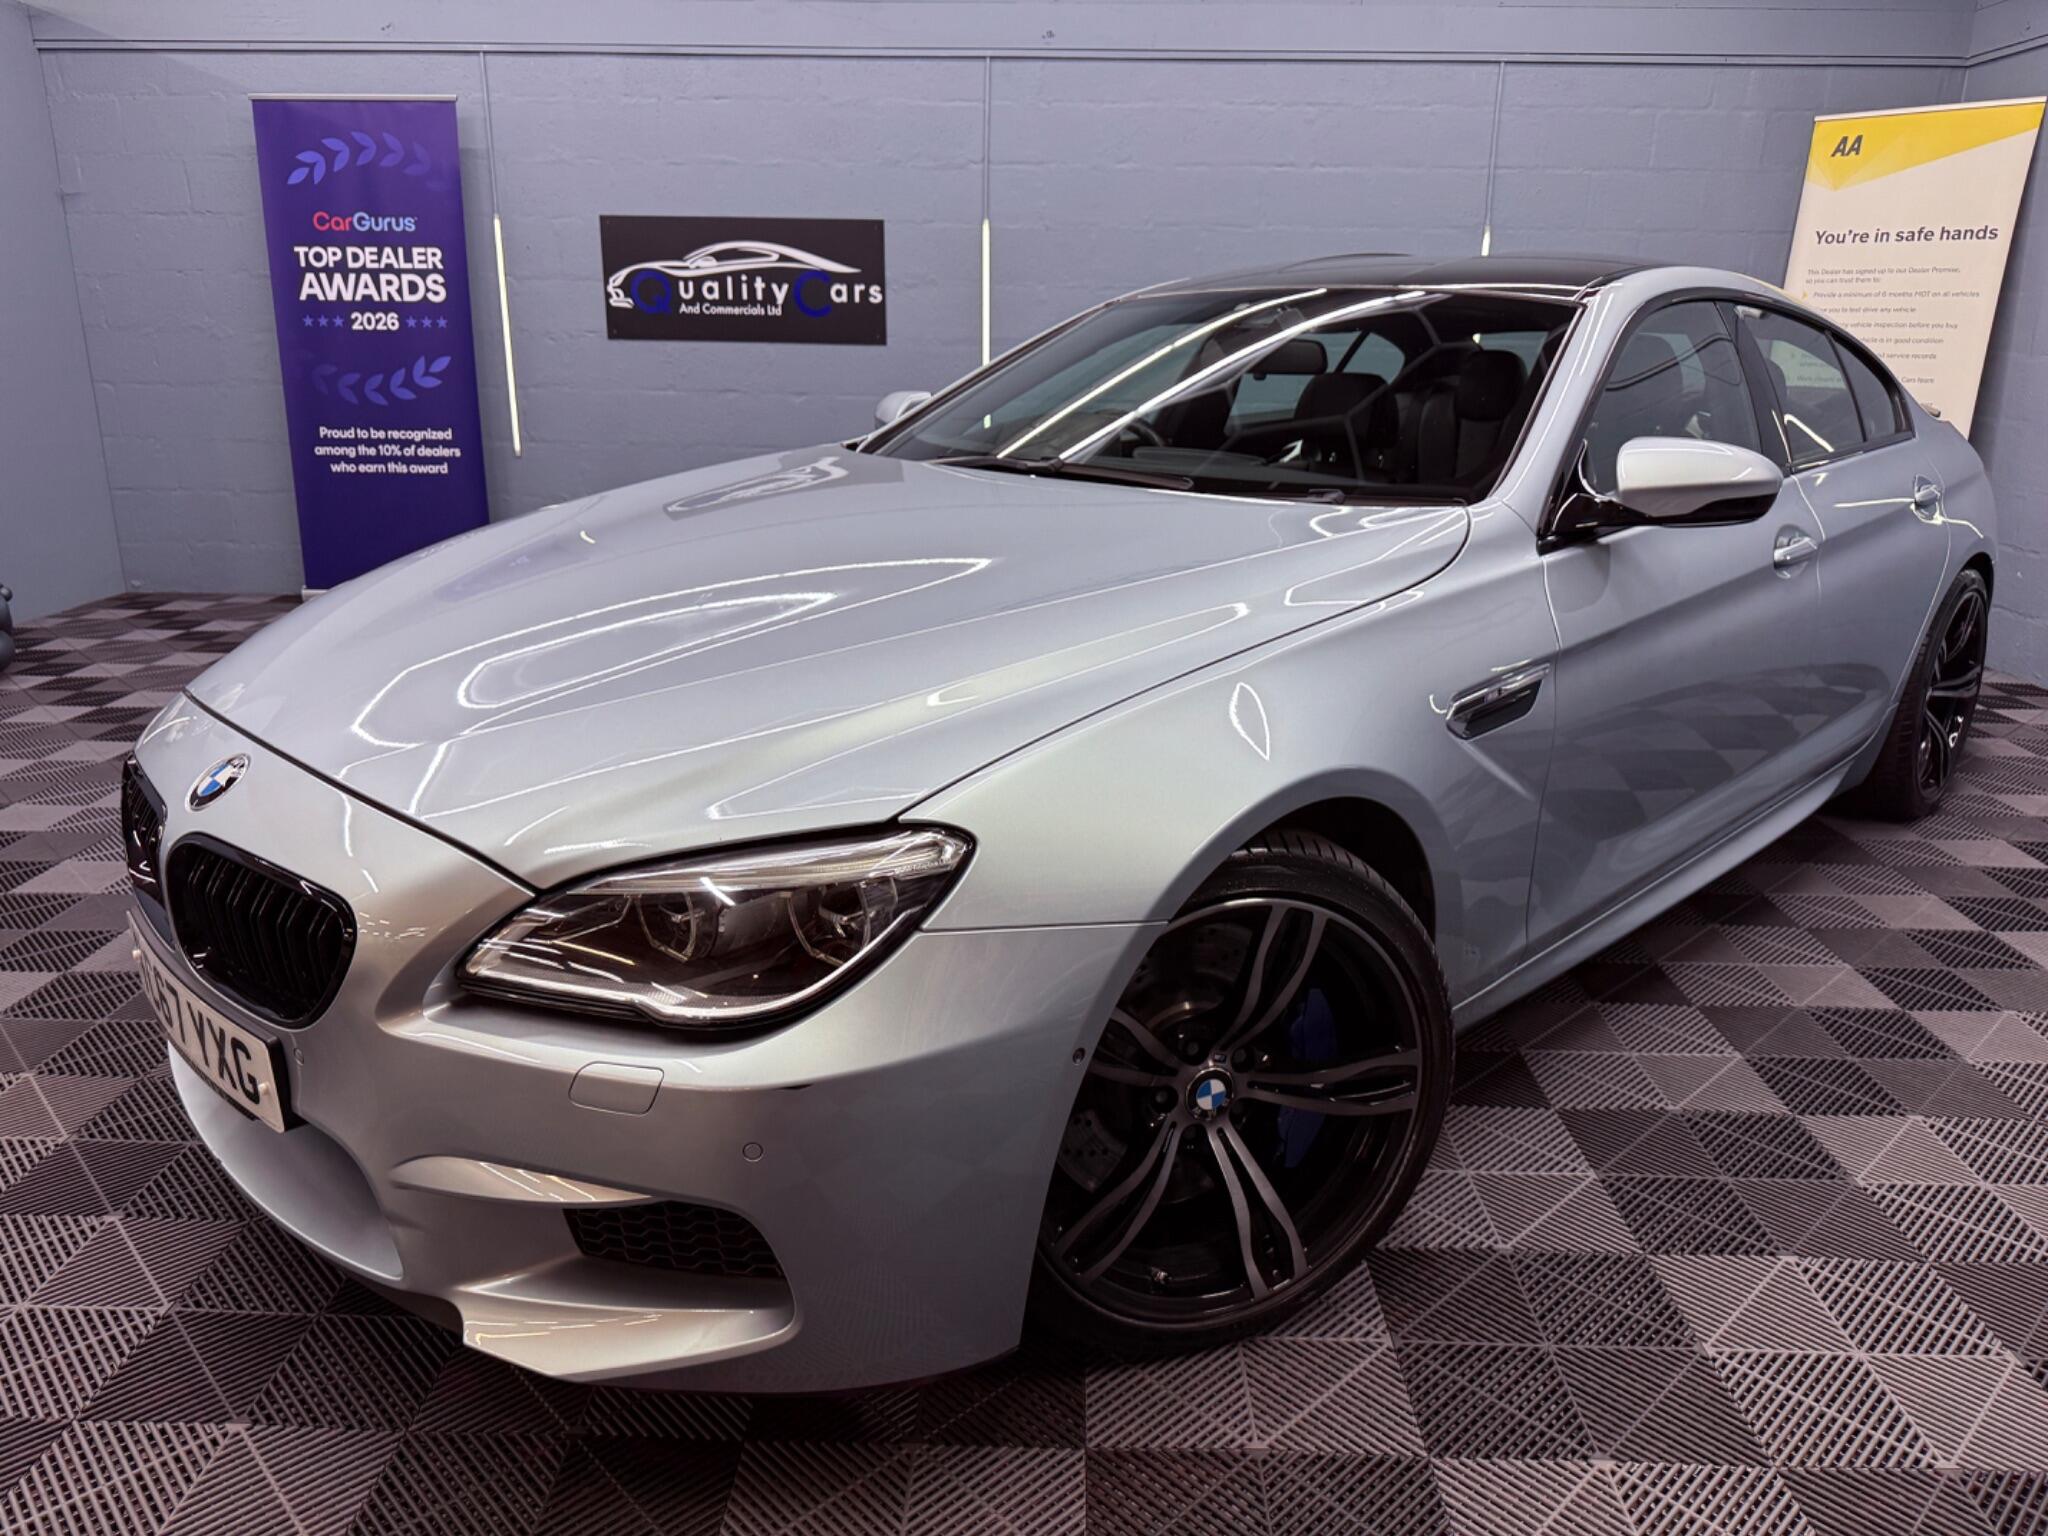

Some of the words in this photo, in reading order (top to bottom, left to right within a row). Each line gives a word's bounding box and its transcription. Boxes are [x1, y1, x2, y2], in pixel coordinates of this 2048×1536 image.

[1830, 134, 1864, 157] AA
[312, 211, 416, 232] CarGurus
[1815, 229, 1870, 245] You're
[1874, 228, 1890, 243] in
[1895, 226, 1934, 243] safe
[1939, 225, 1998, 241] hands
[293, 246, 342, 268] TOP
[346, 247, 444, 270] DEALER
[299, 272, 447, 303] AWARDS
[630, 270, 790, 315] Quality
[793, 270, 883, 318] Cars
[679, 303, 701, 315] And
[702, 303, 766, 317] Commercials
[767, 304, 783, 317] Ltd
[350, 312, 400, 331] 2026
[319, 426, 355, 439] Proud
[356, 427, 369, 440] to
[370, 427, 386, 440] be
[387, 427, 453, 442] recognized
[314, 446, 356, 458] among
[358, 445, 376, 456] the
[378, 444, 402, 457] 10%
[404, 445, 416, 457] of
[417, 445, 461, 458] dealers
[330, 461, 357, 473] who
[358, 464, 386, 474] earn
[387, 462, 408, 474] this
[409, 462, 449, 475] award
[186, 999, 261, 1106] YXG
